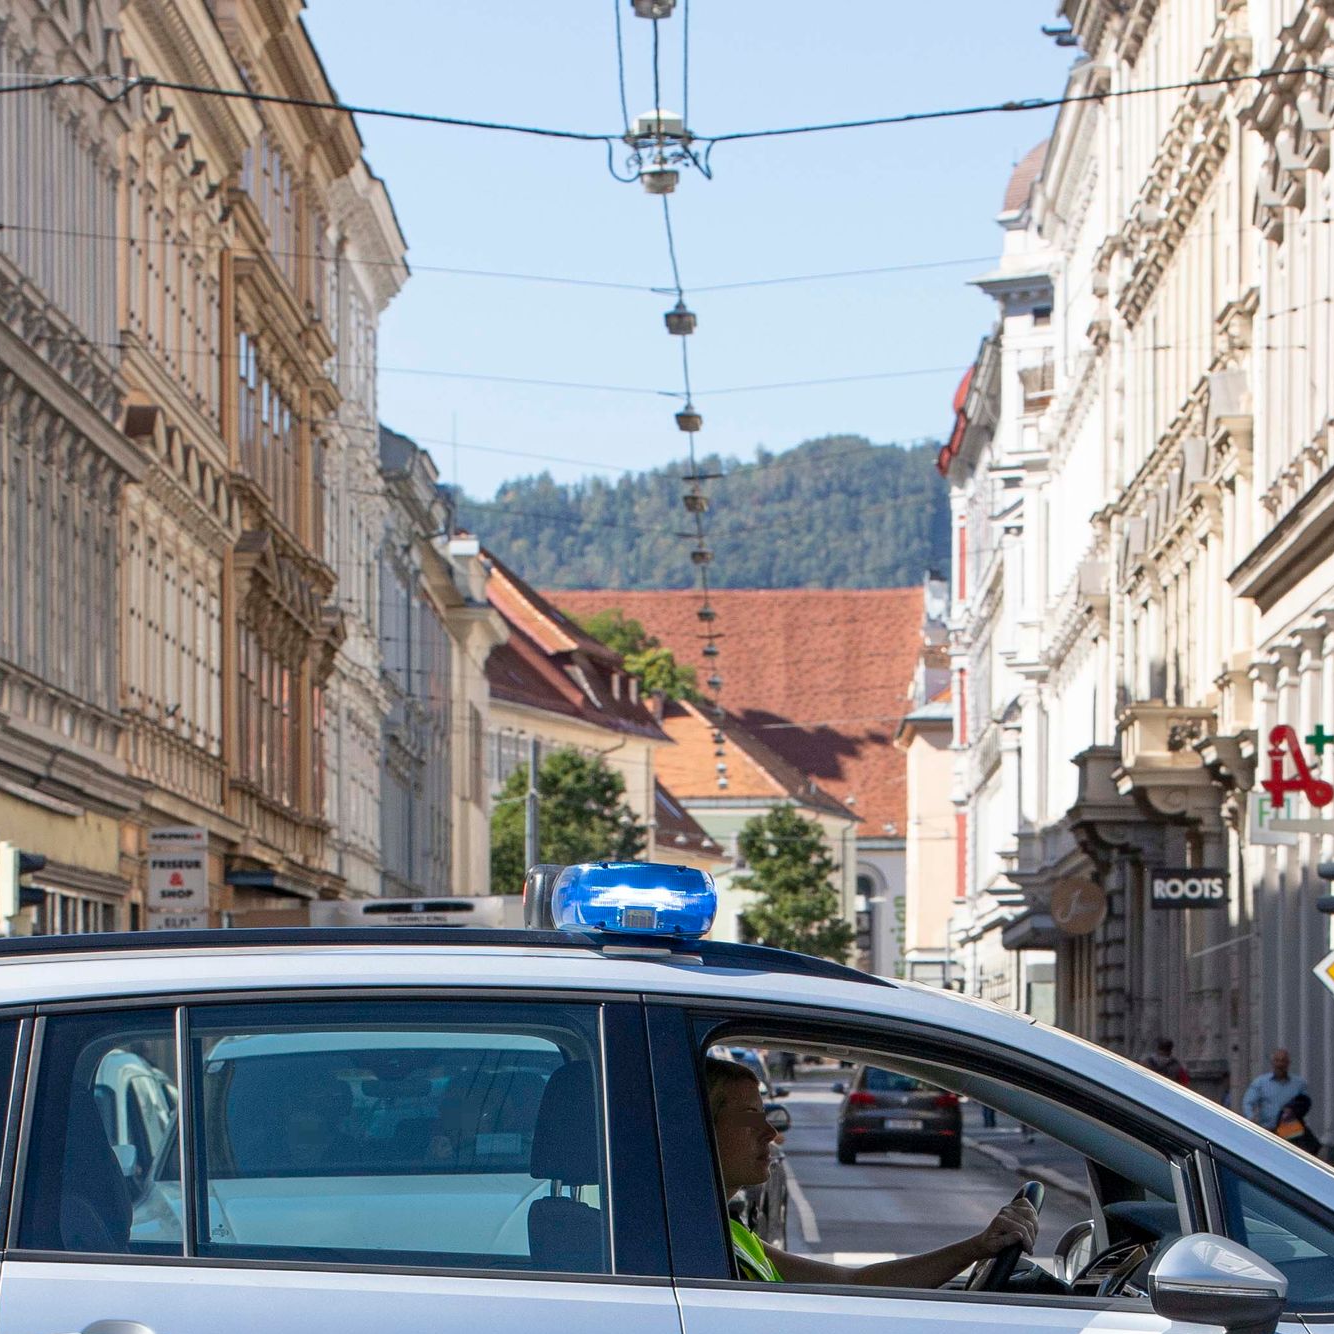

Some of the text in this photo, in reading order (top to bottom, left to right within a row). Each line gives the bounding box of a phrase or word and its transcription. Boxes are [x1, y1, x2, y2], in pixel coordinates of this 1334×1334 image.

[151, 859, 202, 870] FRISEUR
[160, 889, 194, 899] SHOP
[1152, 877, 1224, 900] ROOTS
